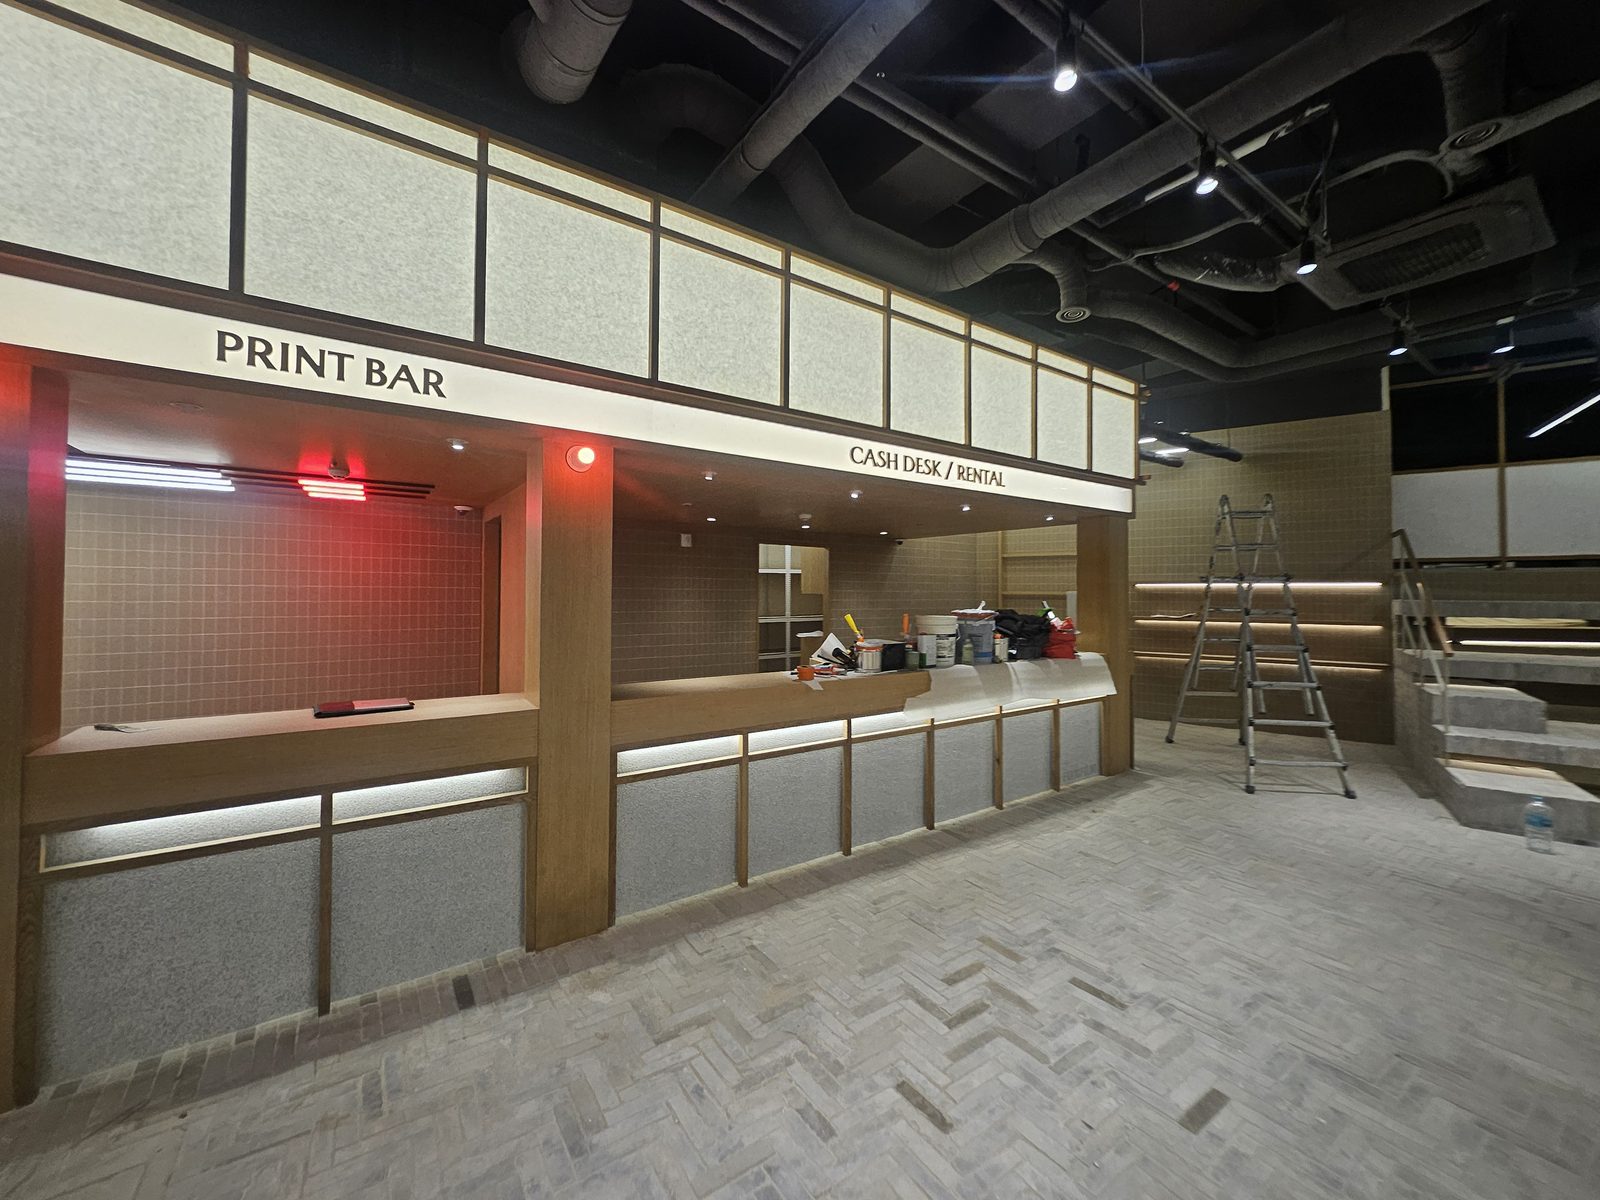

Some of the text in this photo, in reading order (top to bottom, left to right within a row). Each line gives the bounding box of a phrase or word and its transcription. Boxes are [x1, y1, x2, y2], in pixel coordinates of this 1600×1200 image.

[216, 330, 446, 398] PRINT BAR
[850, 446, 1006, 487] CASH DESK / RENTAL
